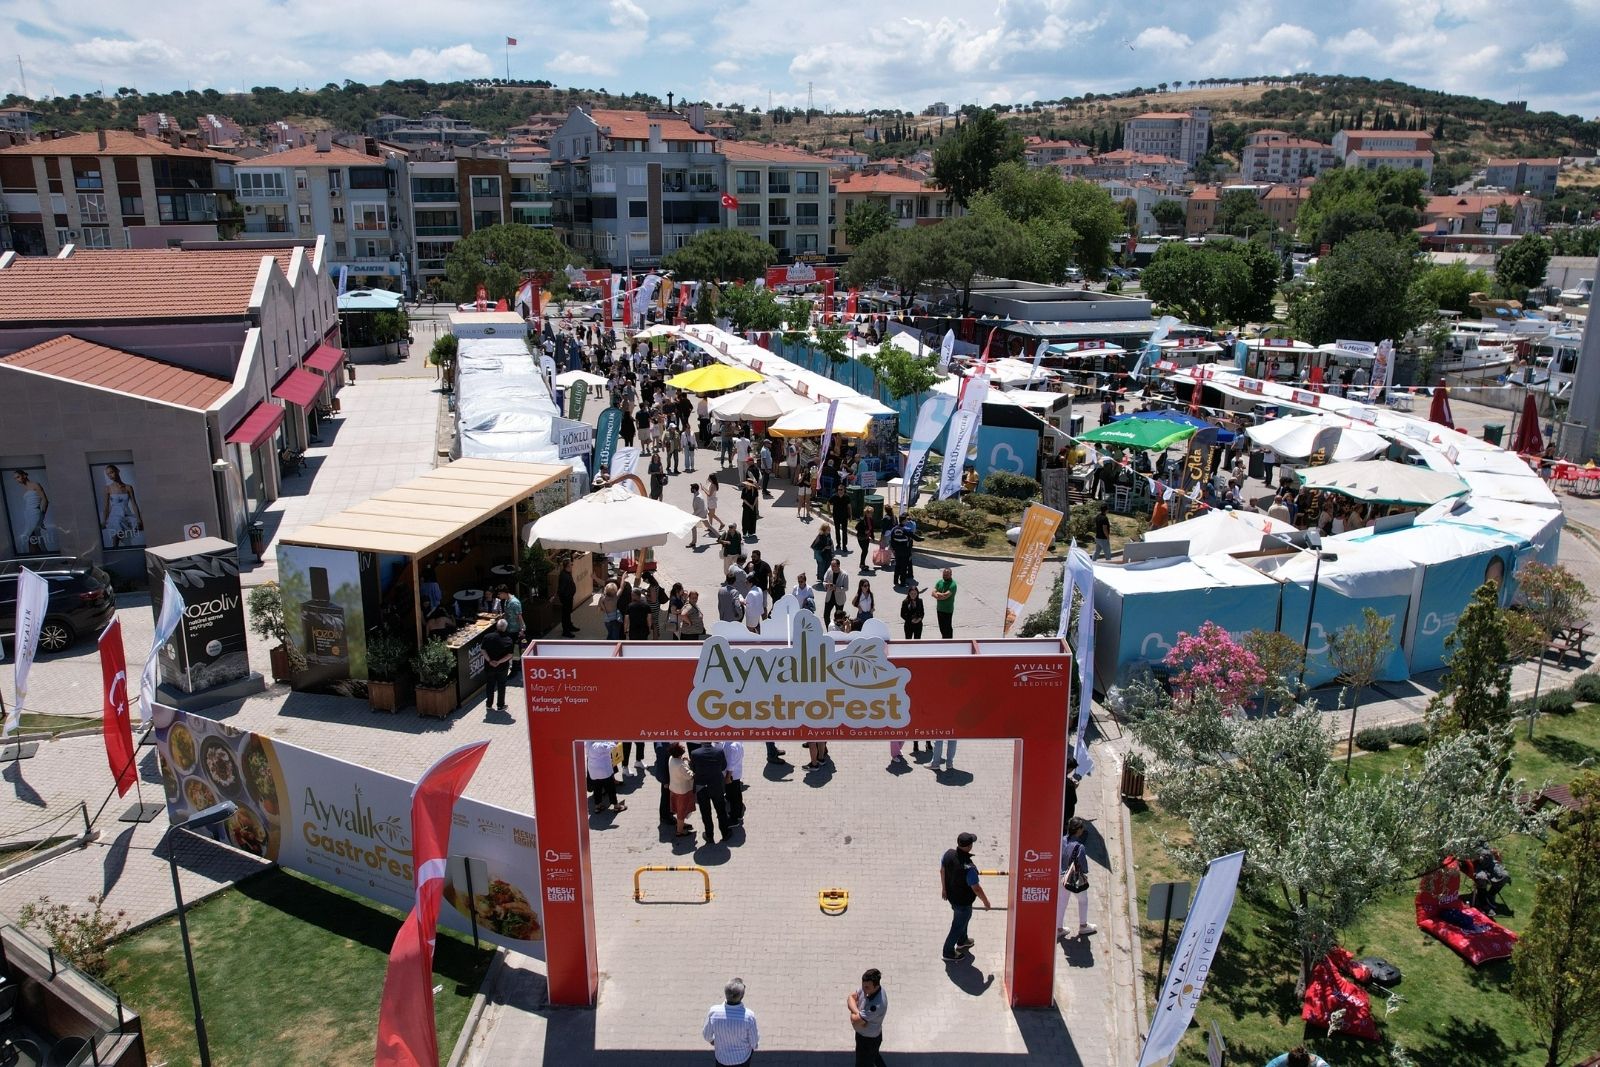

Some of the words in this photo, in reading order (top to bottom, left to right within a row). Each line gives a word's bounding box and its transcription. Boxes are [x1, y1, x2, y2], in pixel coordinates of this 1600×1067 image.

[562, 429, 589, 446] KÖKLÜ
[530, 668, 577, 679] 30-31-1
[703, 631, 829, 693] Ayvalık
[564, 684, 598, 692] Haziran
[696, 688, 902, 721] GastroFest
[849, 729, 910, 738] Gastronomy
[304, 787, 375, 839] Ayvalık
[303, 821, 414, 880] GastroFes
